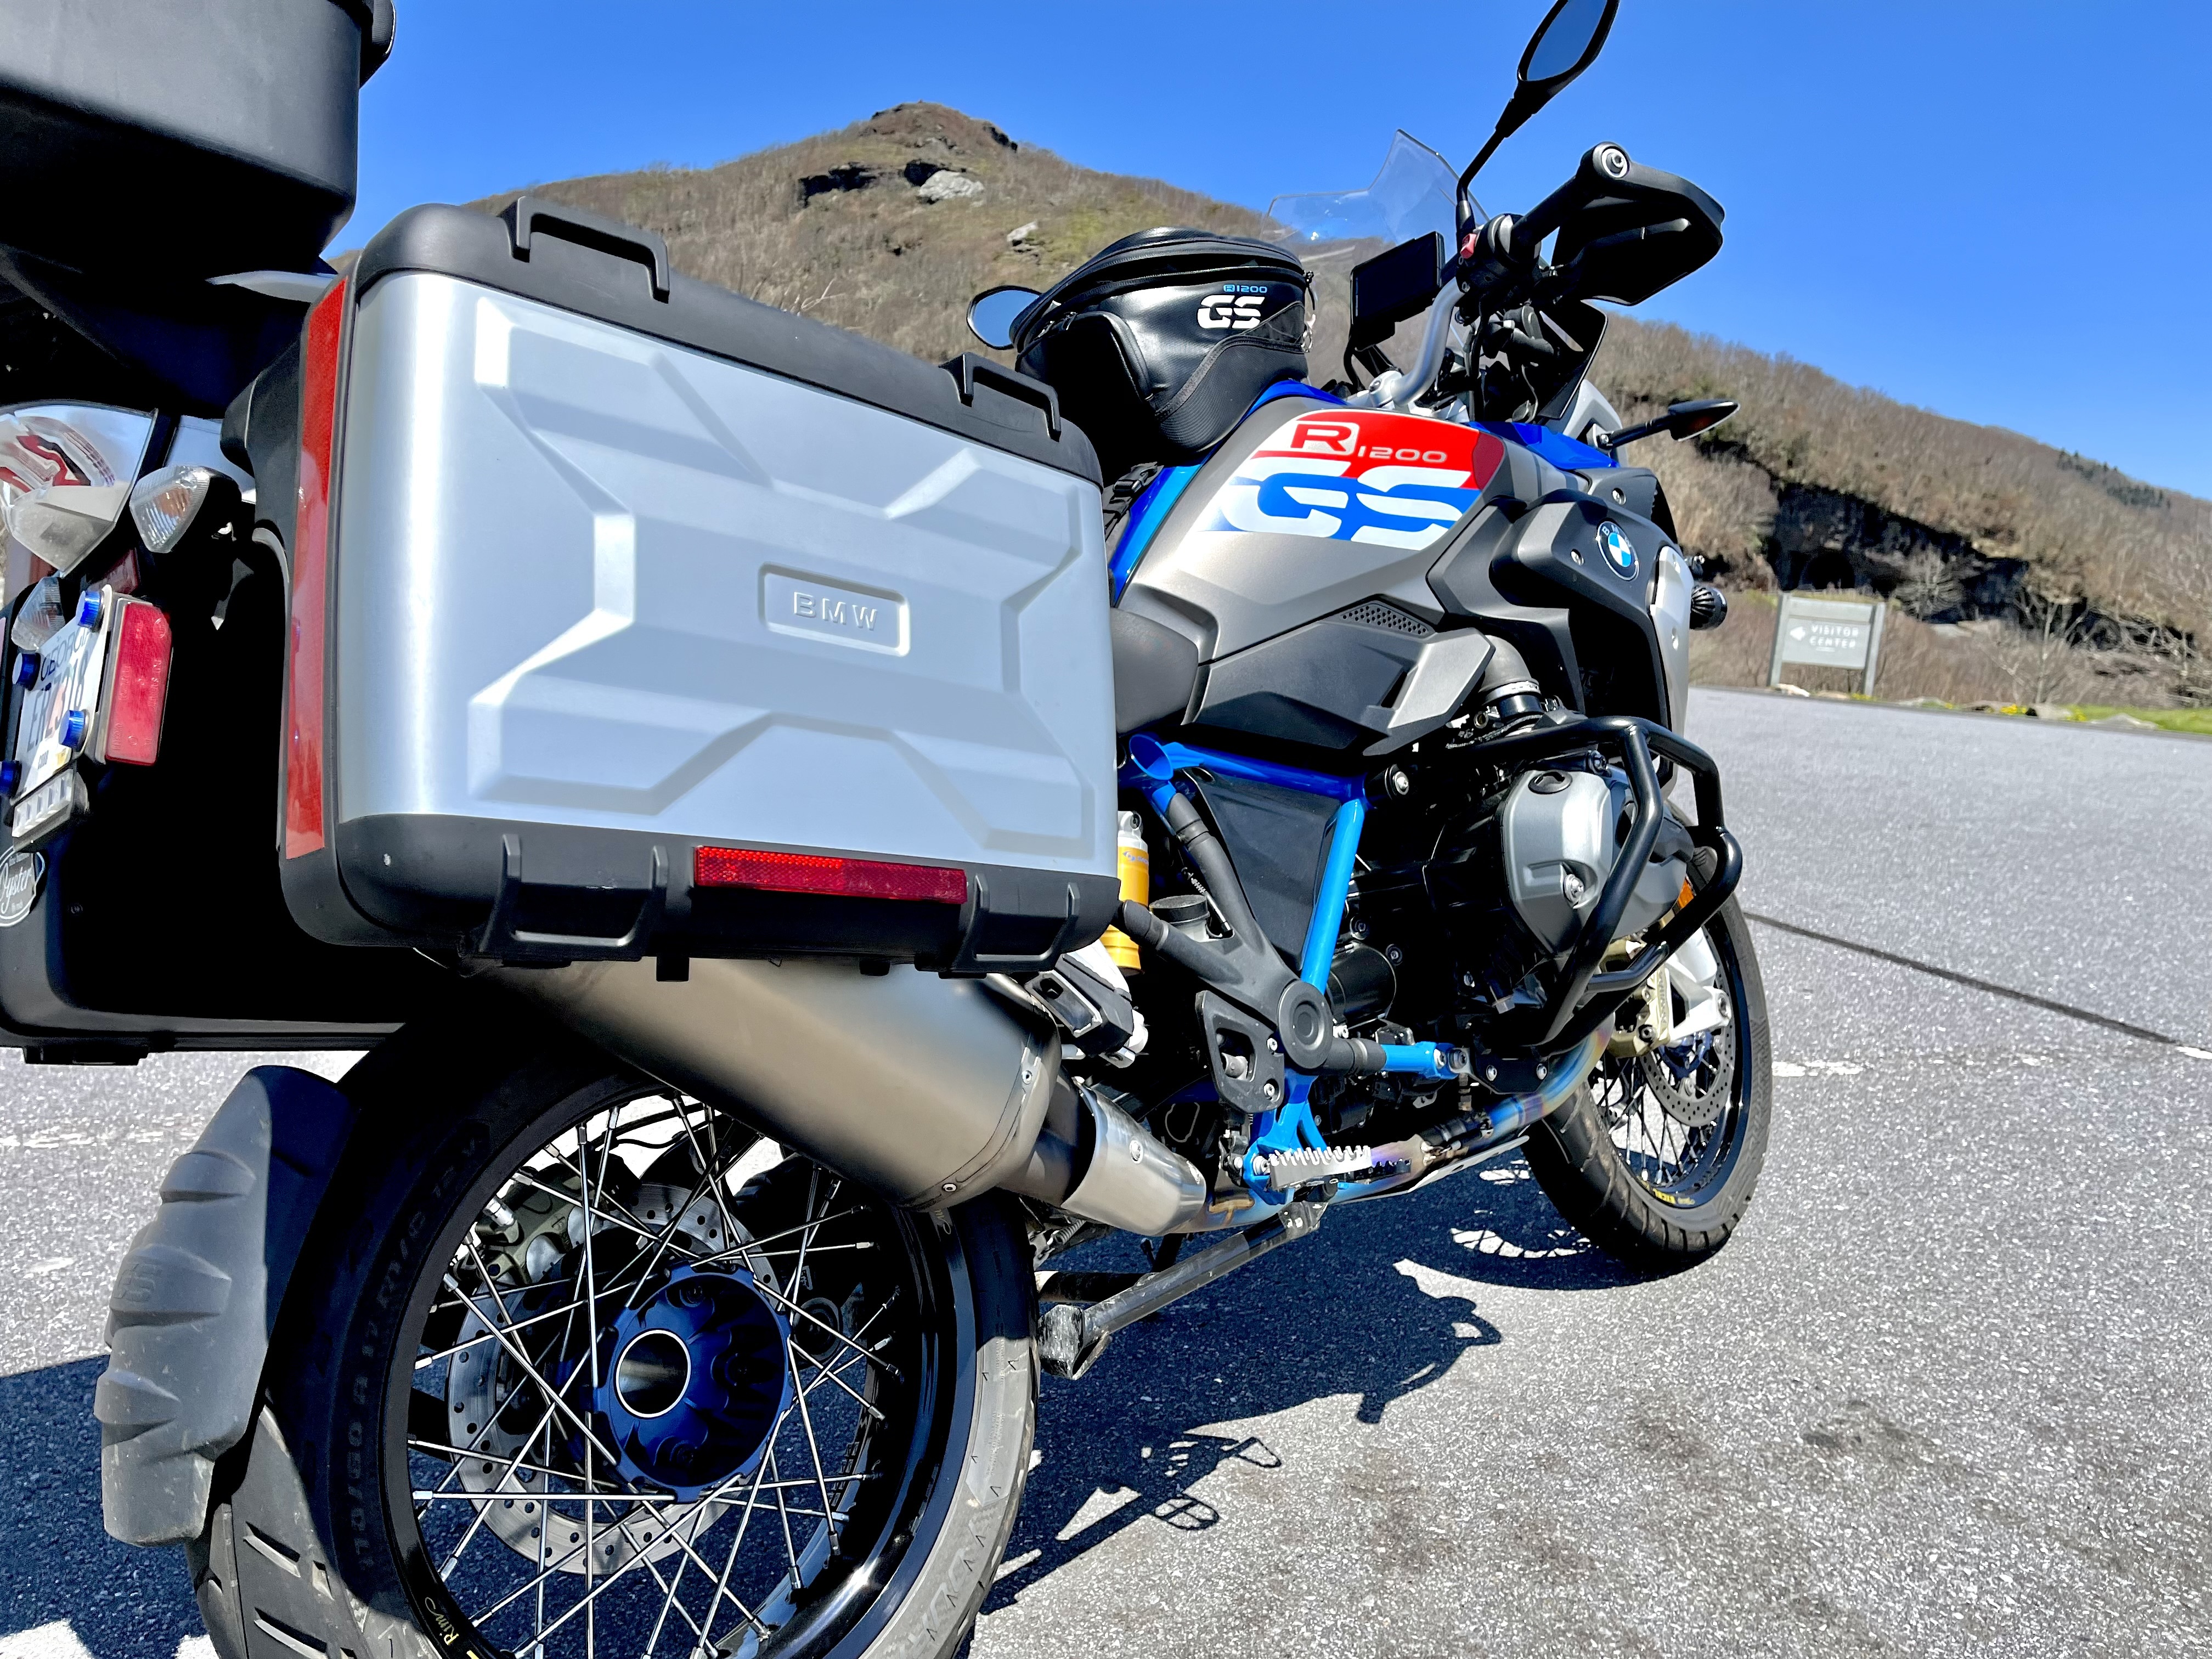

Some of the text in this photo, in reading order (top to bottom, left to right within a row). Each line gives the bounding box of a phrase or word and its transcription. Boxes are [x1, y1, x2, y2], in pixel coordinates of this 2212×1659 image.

[1197, 295, 1266, 329] GS
[1221, 456, 1472, 551] GS
[794, 591, 878, 631] BMW
[1809, 635, 1857, 649] CENTER
[1812, 624, 1859, 637] VISITOR
